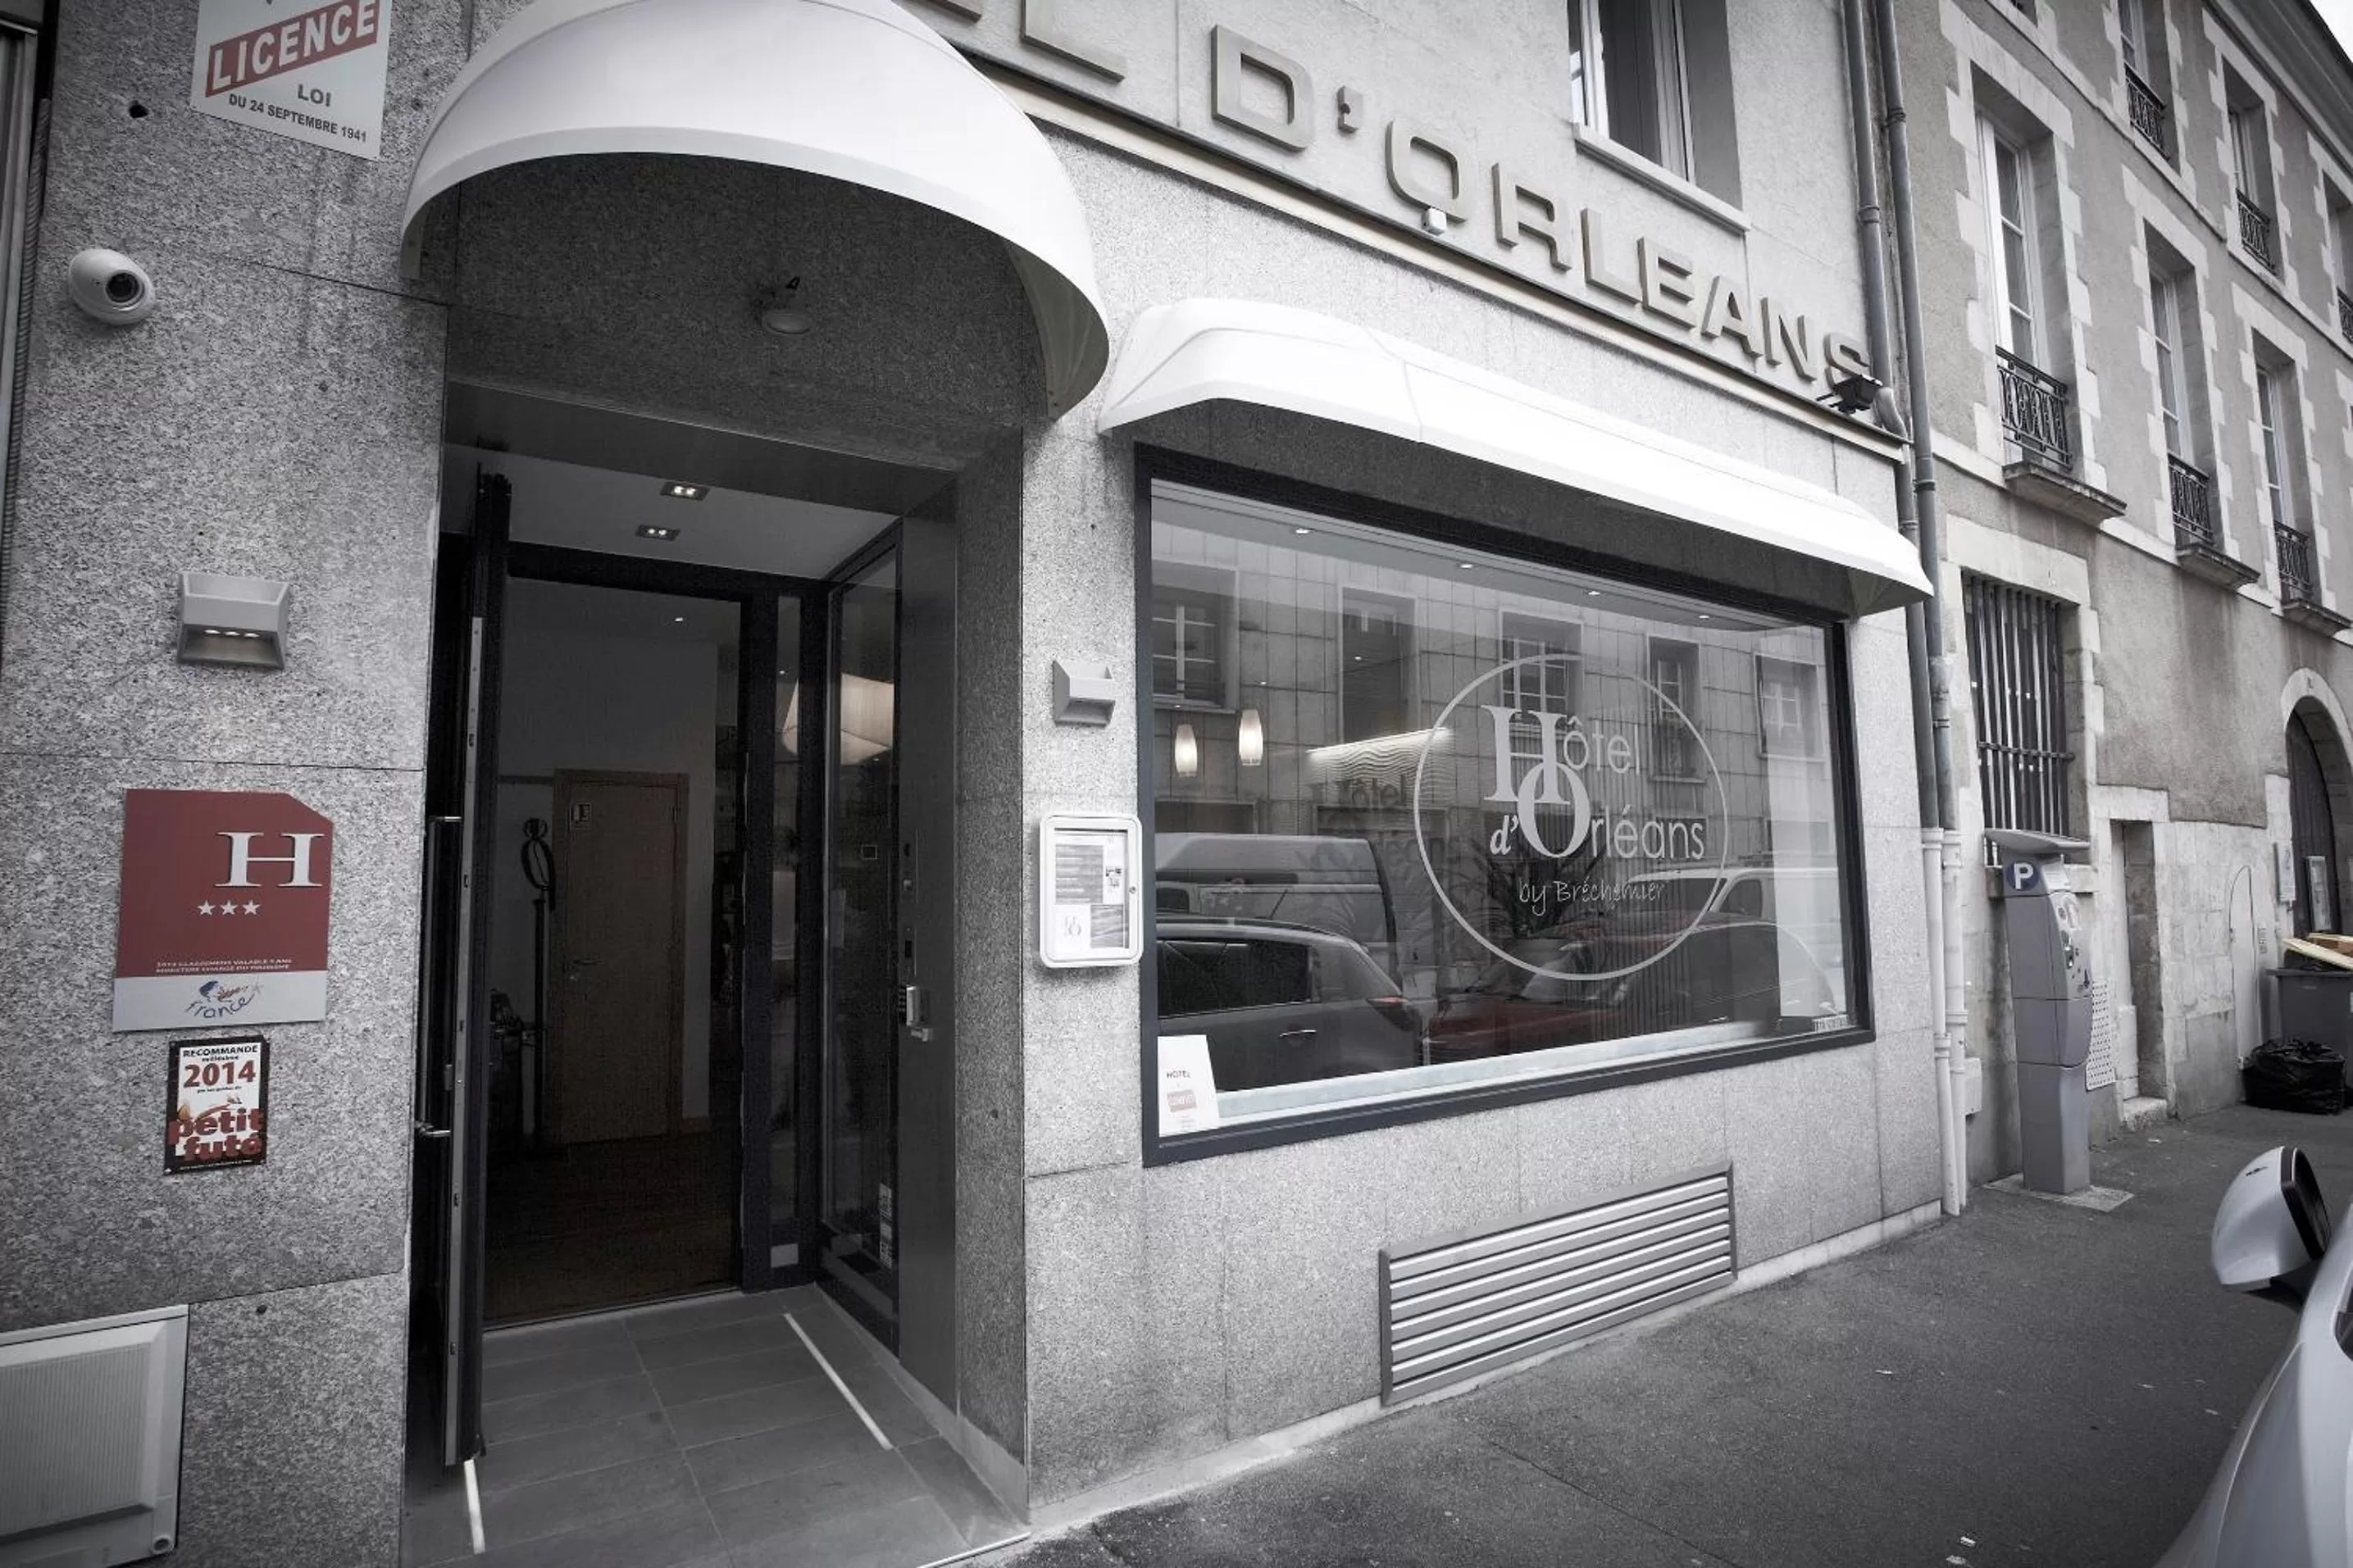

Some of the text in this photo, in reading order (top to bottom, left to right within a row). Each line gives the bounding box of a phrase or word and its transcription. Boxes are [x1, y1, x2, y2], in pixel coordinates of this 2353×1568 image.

[212, 0, 375, 90] LICENCE
[297, 84, 332, 107] LOI
[228, 93, 367, 143] DU 24 SEPTEMBRE 1941
[1481, 704, 1641, 805] Hôtel
[214, 831, 325, 888] H
[2014, 862, 2034, 890] P
[1519, 876, 1547, 917] by
[183, 1060, 257, 1089] 2014
[168, 1107, 263, 1146] petit
